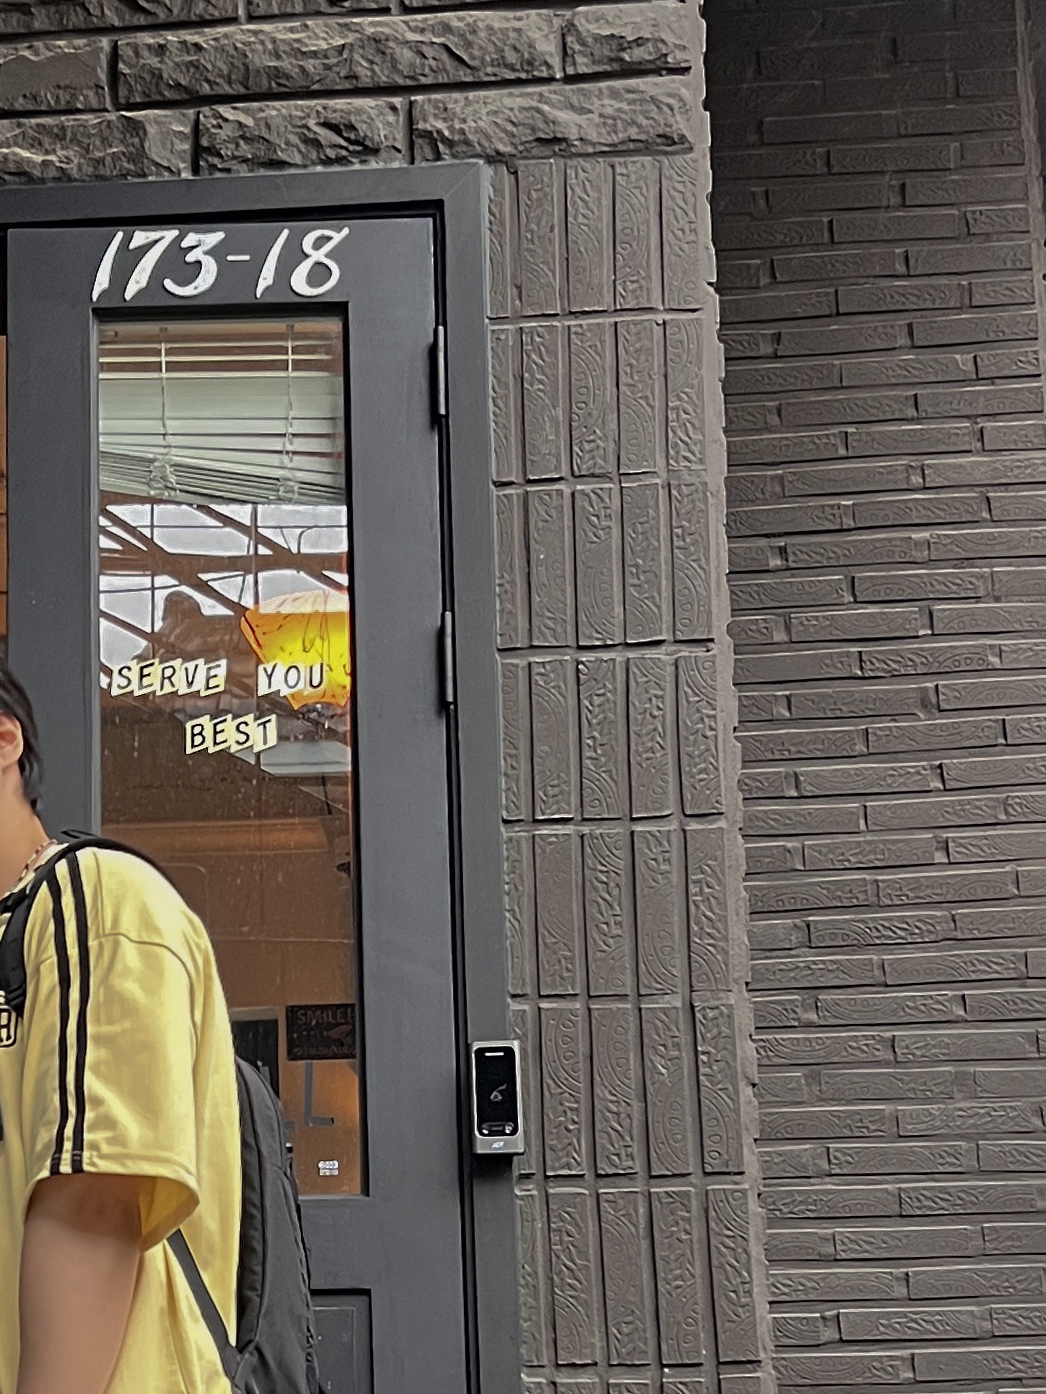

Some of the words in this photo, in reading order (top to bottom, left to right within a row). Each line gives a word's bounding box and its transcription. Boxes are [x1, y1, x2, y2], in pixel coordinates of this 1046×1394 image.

[92, 226, 350, 302] 173-18
[116, 661, 223, 692] SERVE
[262, 662, 325, 691] YOU
[189, 717, 275, 749] BEST
